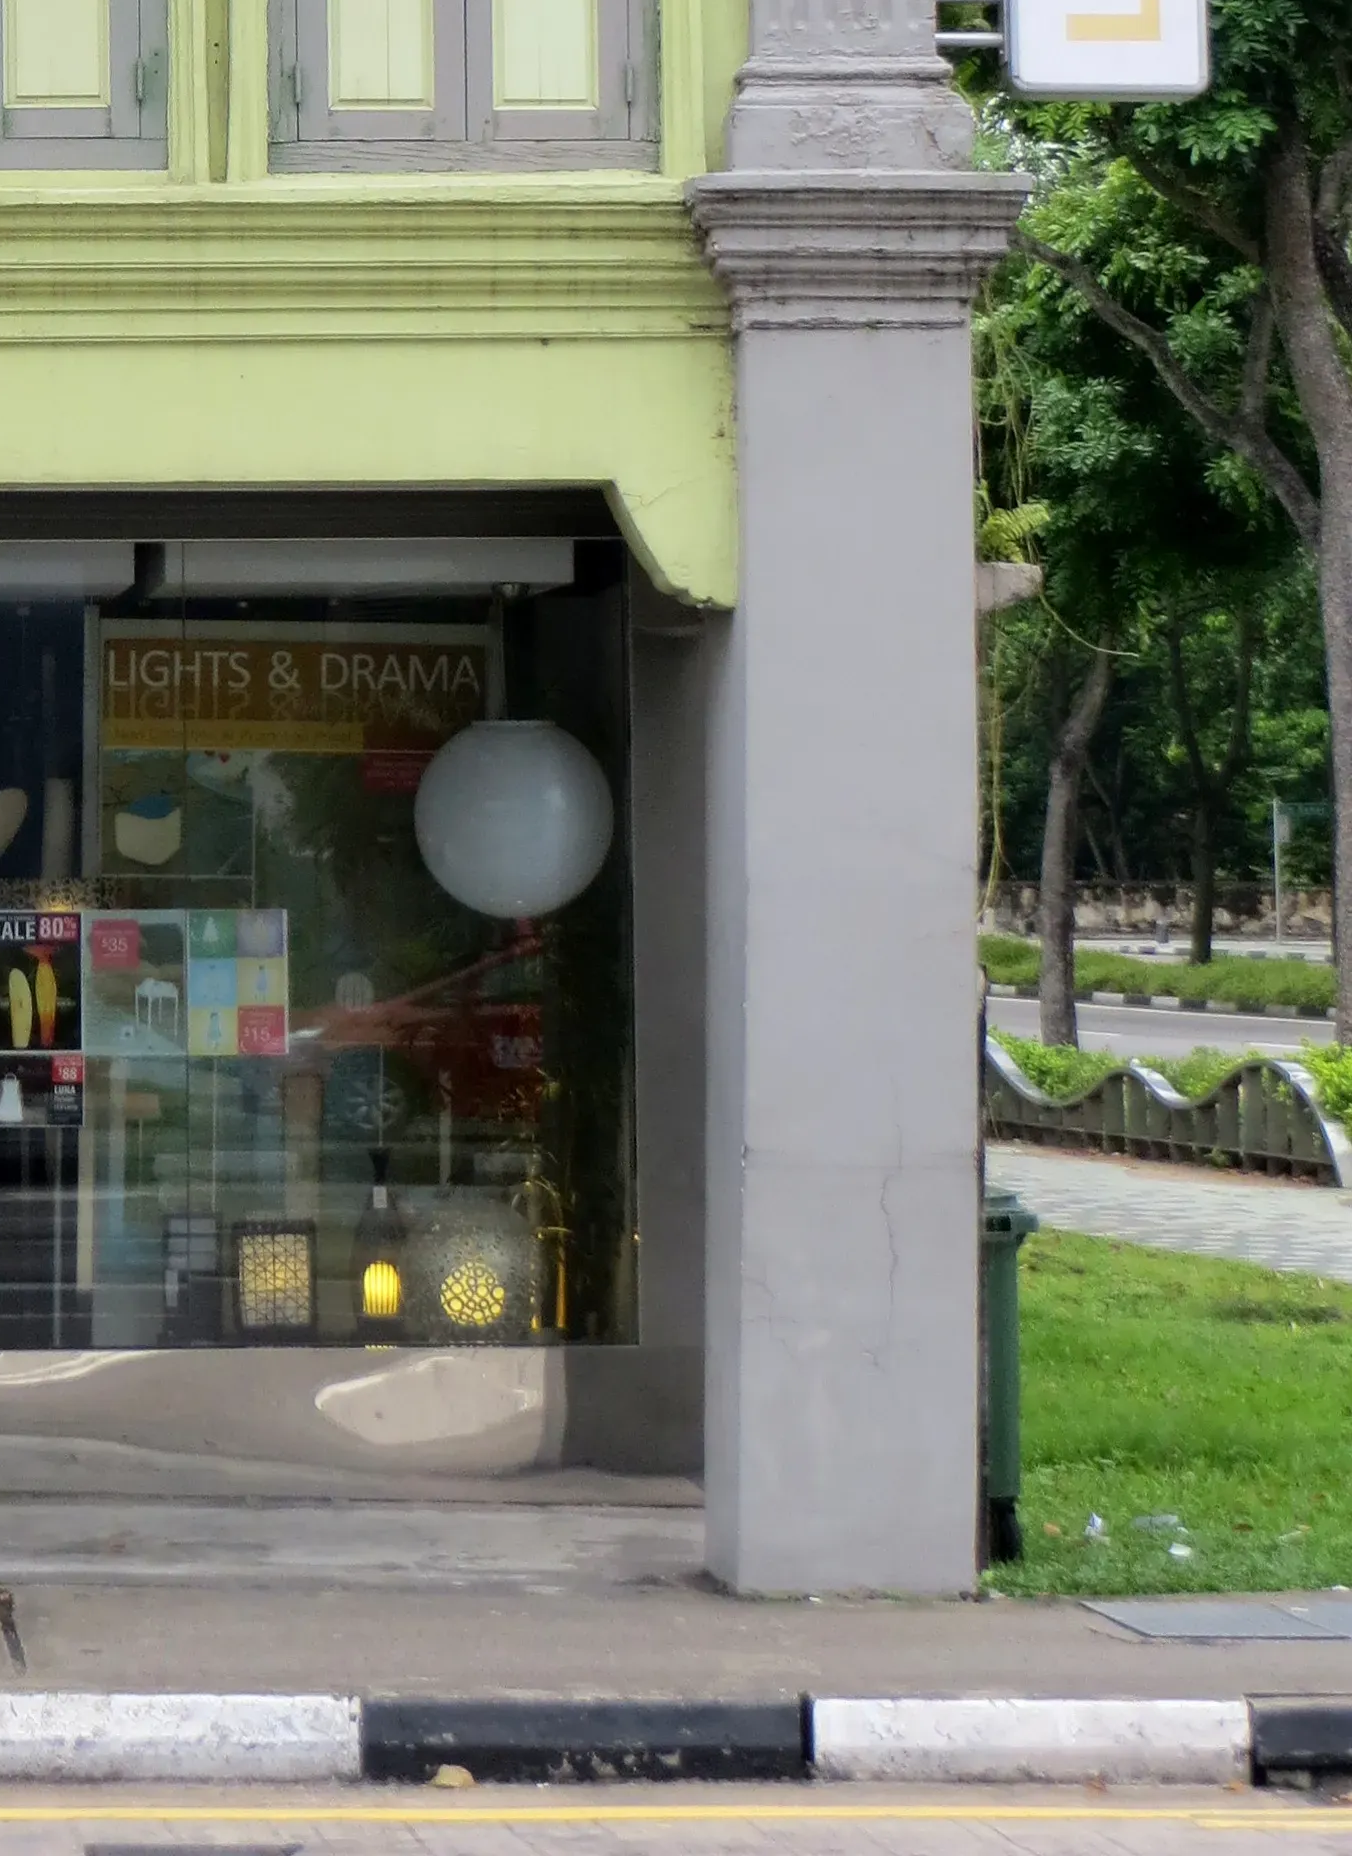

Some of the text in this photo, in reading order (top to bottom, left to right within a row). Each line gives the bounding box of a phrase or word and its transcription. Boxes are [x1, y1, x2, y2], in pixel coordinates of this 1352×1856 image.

[108, 649, 481, 694] LIGHTS & DRAMA
[101, 937, 129, 952] $35
